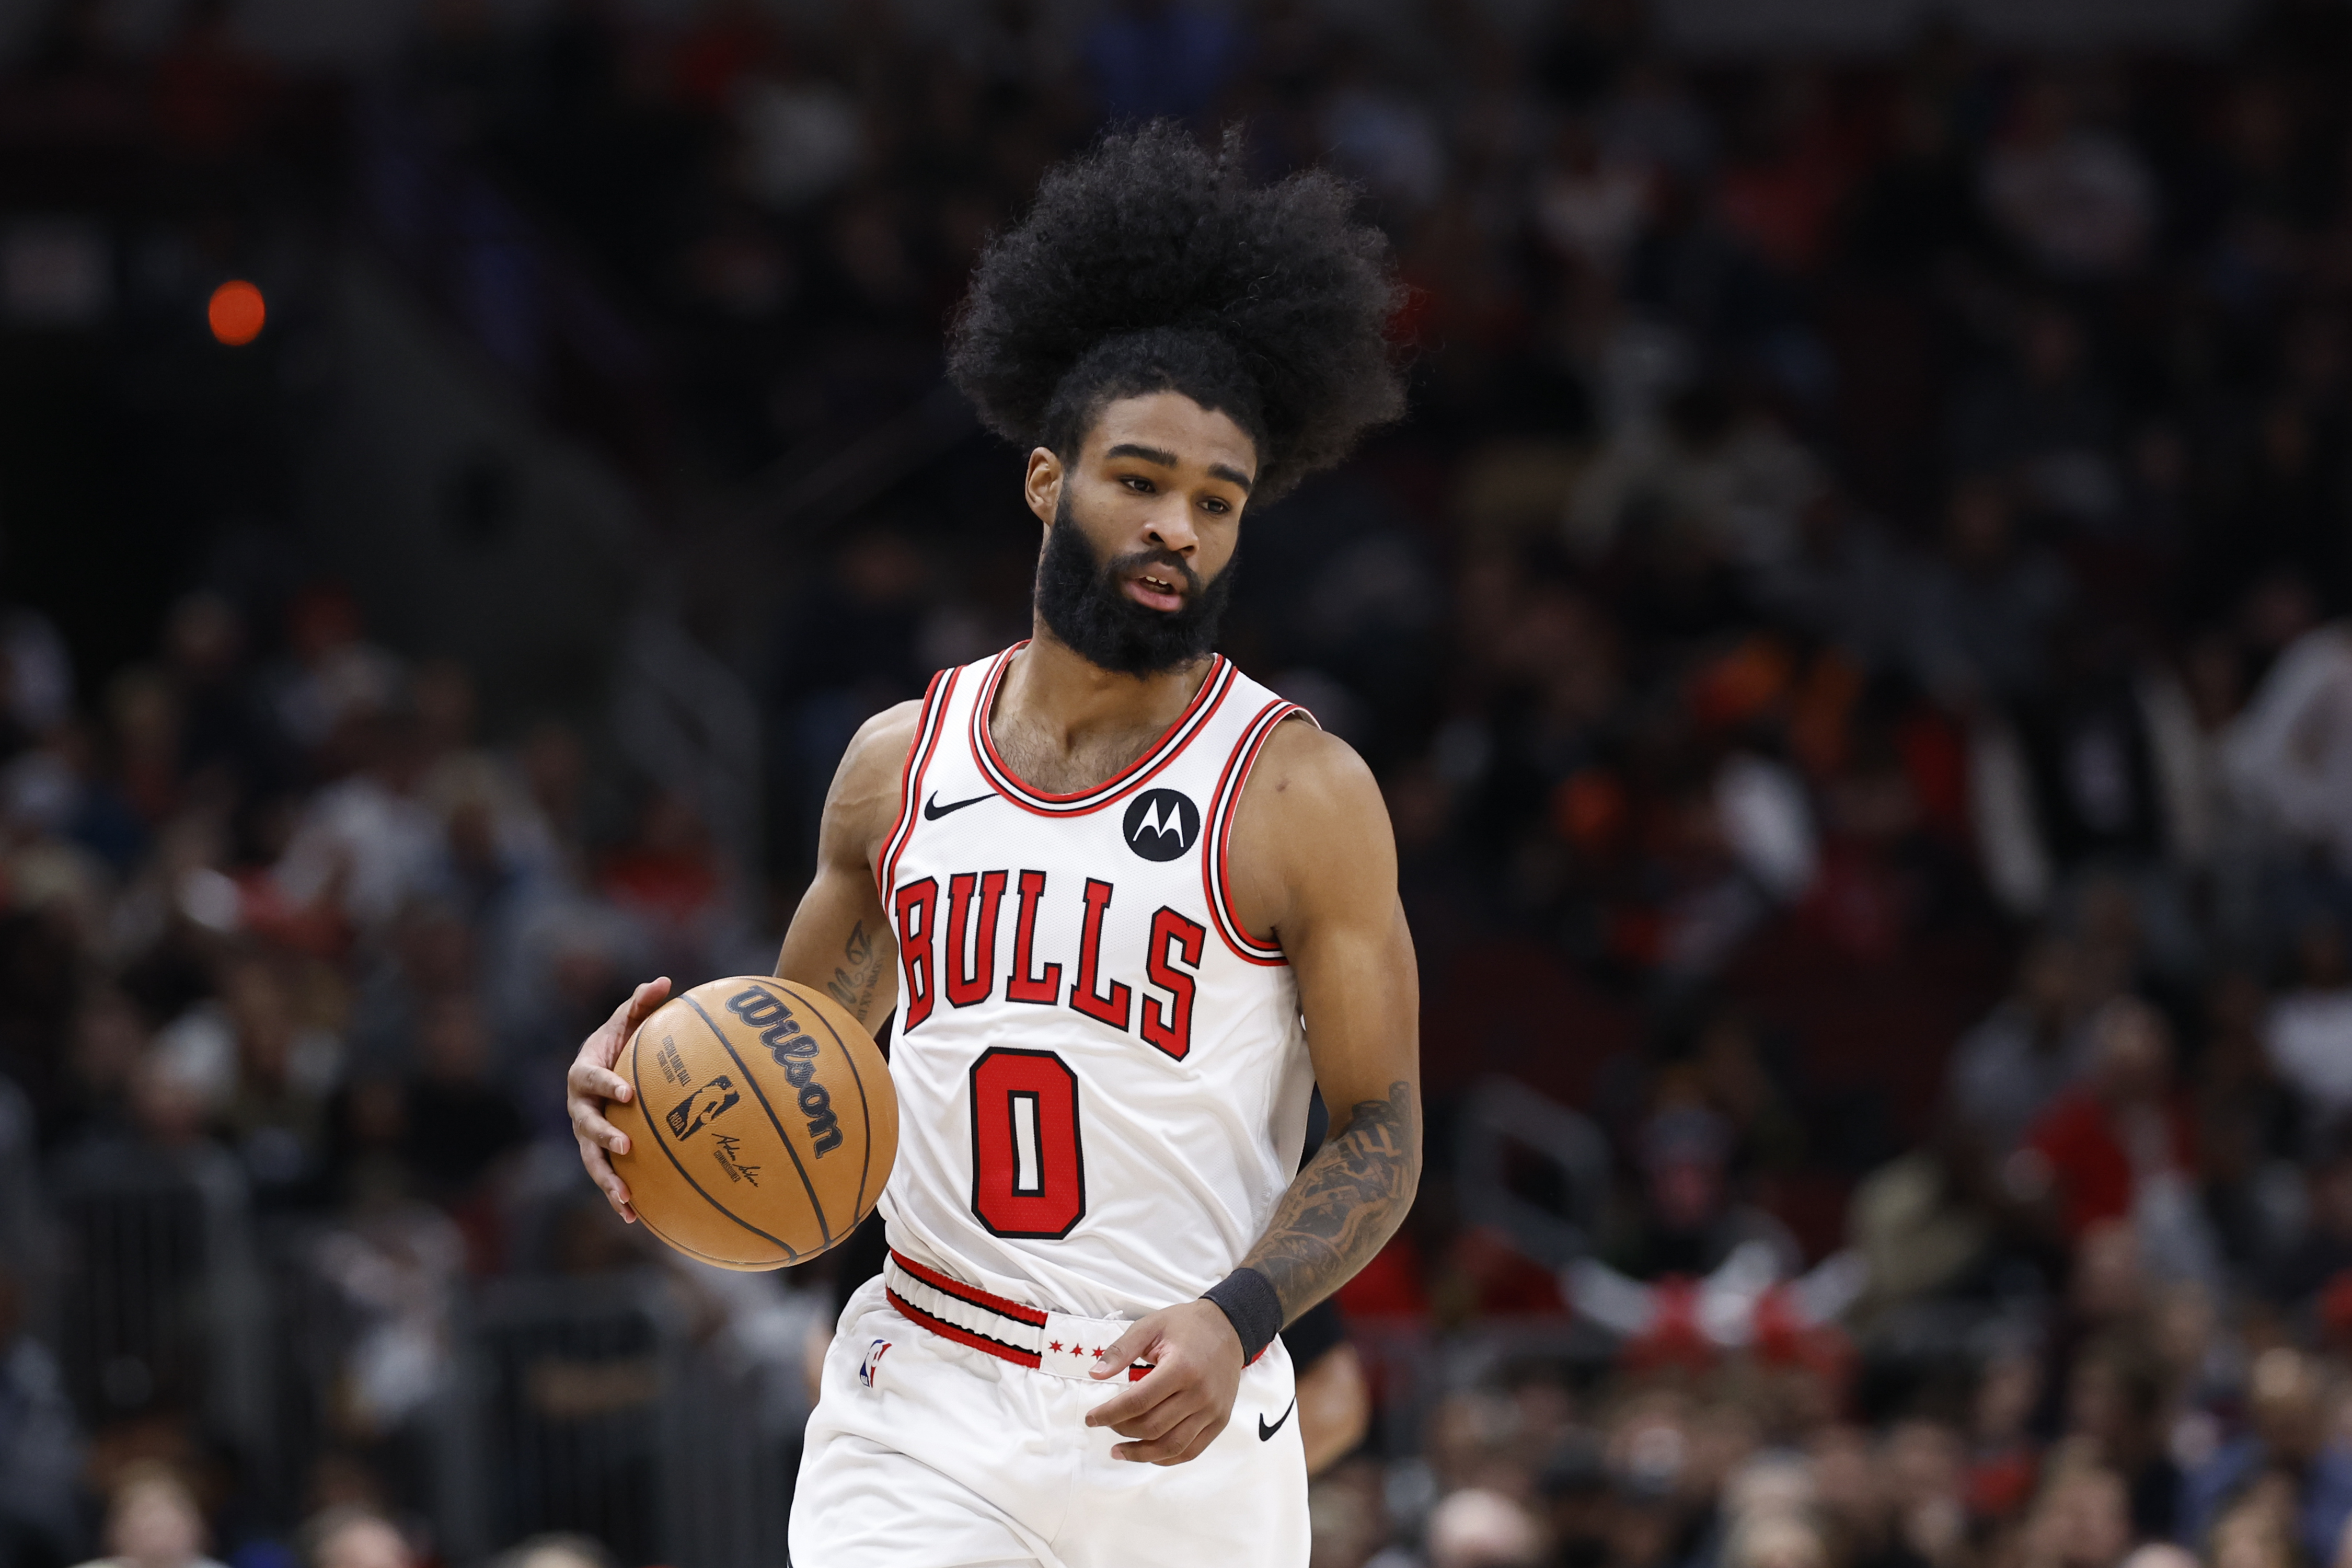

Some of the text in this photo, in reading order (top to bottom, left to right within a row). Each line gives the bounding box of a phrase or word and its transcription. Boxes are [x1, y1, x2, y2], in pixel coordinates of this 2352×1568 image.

[895, 869, 1206, 1062] BULLS
[670, 1054, 685, 1074] GAME
[677, 1069, 691, 1087] BALL
[725, 985, 843, 1159] Wilson
[668, 1111, 685, 1132] NBA
[970, 1046, 1086, 1240] 0
[713, 1149, 741, 1183] COMMISSIONER
